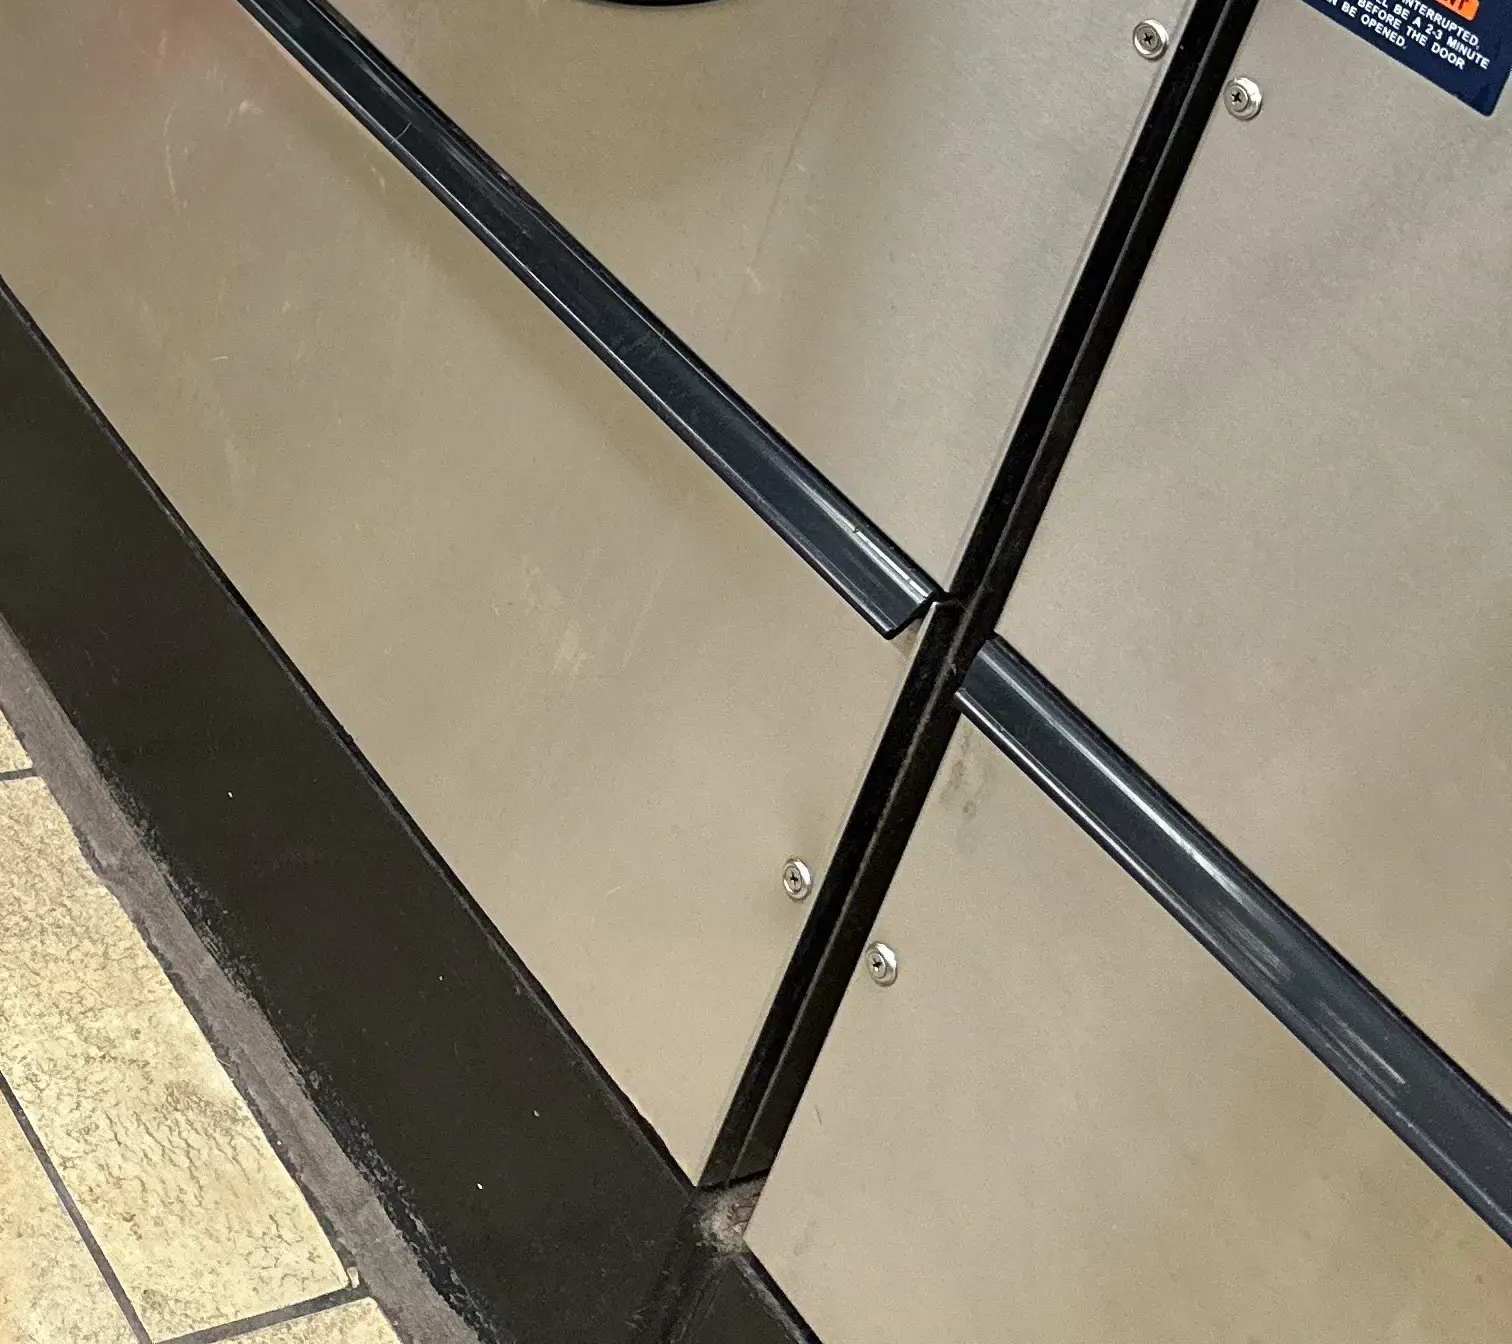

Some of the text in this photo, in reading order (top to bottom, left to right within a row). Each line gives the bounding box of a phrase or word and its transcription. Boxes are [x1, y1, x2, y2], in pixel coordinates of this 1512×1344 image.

[1341, 1, 1358, 18] BE
[1360, 14, 1408, 51] OPENED.
[1393, 3, 1411, 21] BE
[1411, 14, 1422, 29] A
[1425, 23, 1444, 41] 2-3
[1446, 35, 1491, 71] MINUTE
[1405, 26, 1429, 47] THE
[1430, 41, 1466, 71] DOOR
